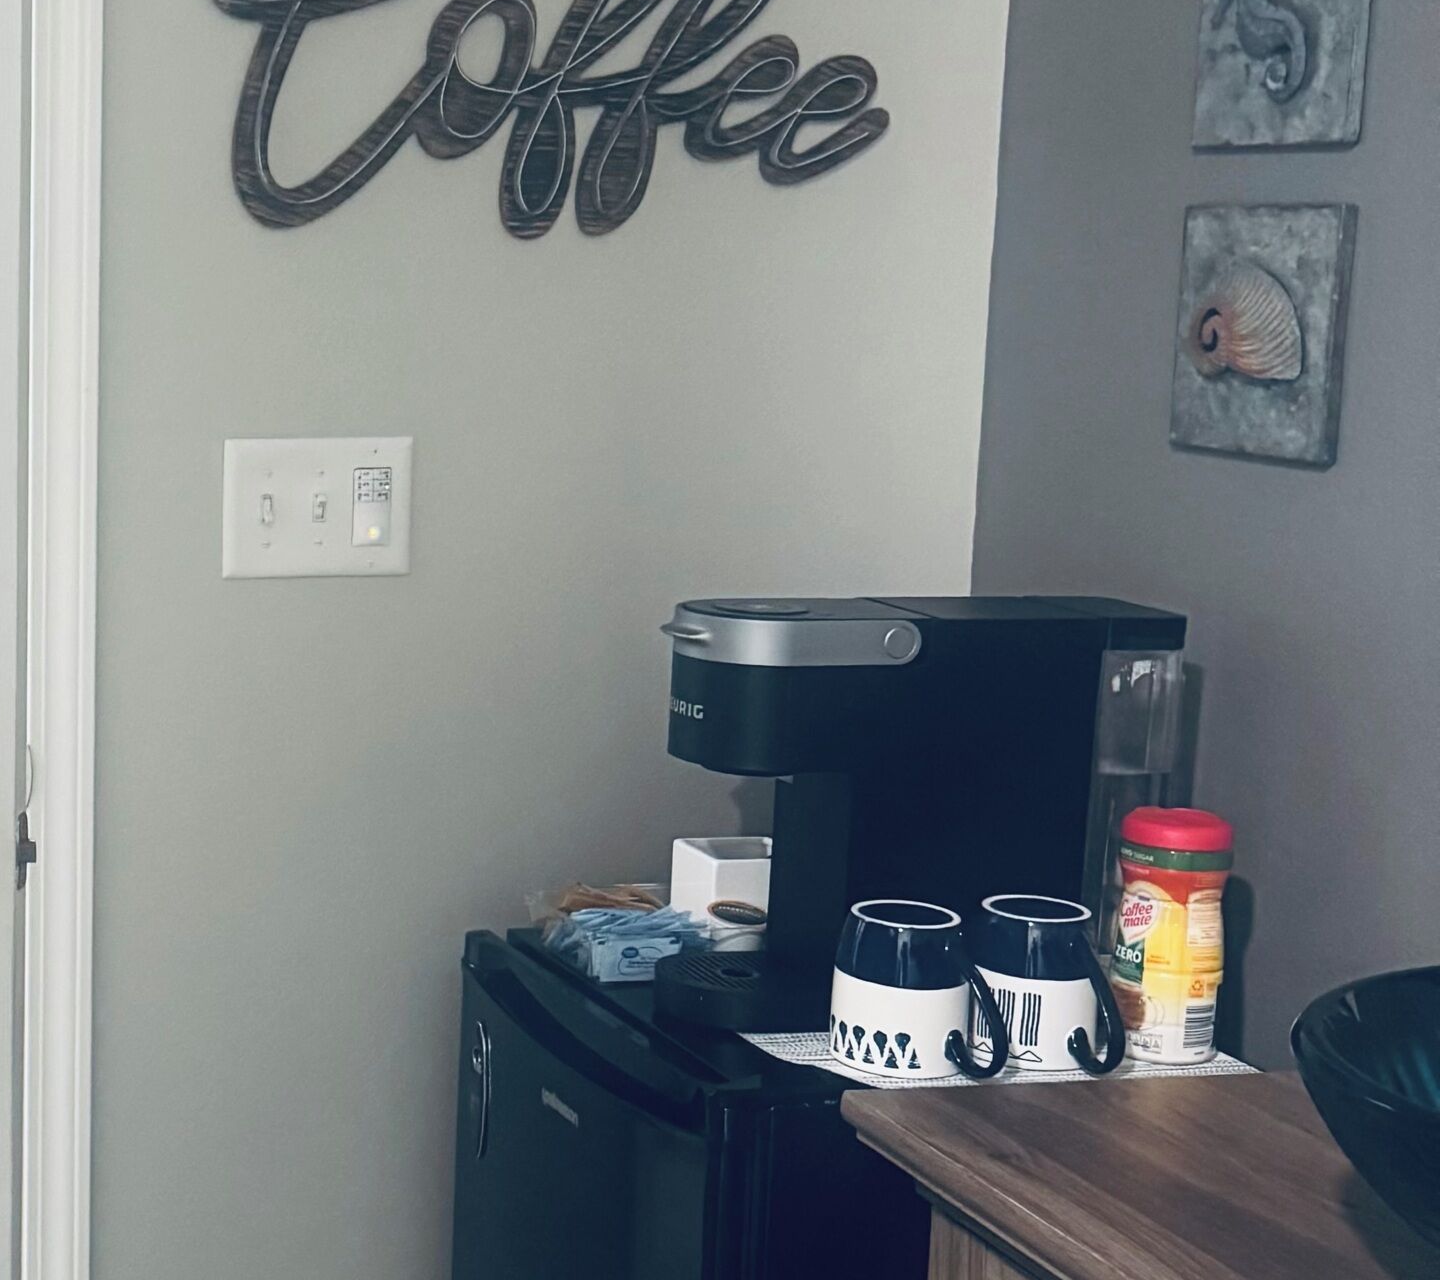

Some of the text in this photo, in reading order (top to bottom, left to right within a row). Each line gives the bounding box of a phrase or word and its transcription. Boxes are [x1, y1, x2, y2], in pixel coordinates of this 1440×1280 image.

[1121, 899, 1153, 917] Coffee
[1123, 915, 1152, 928] mate
[1115, 944, 1142, 963] ZERO
